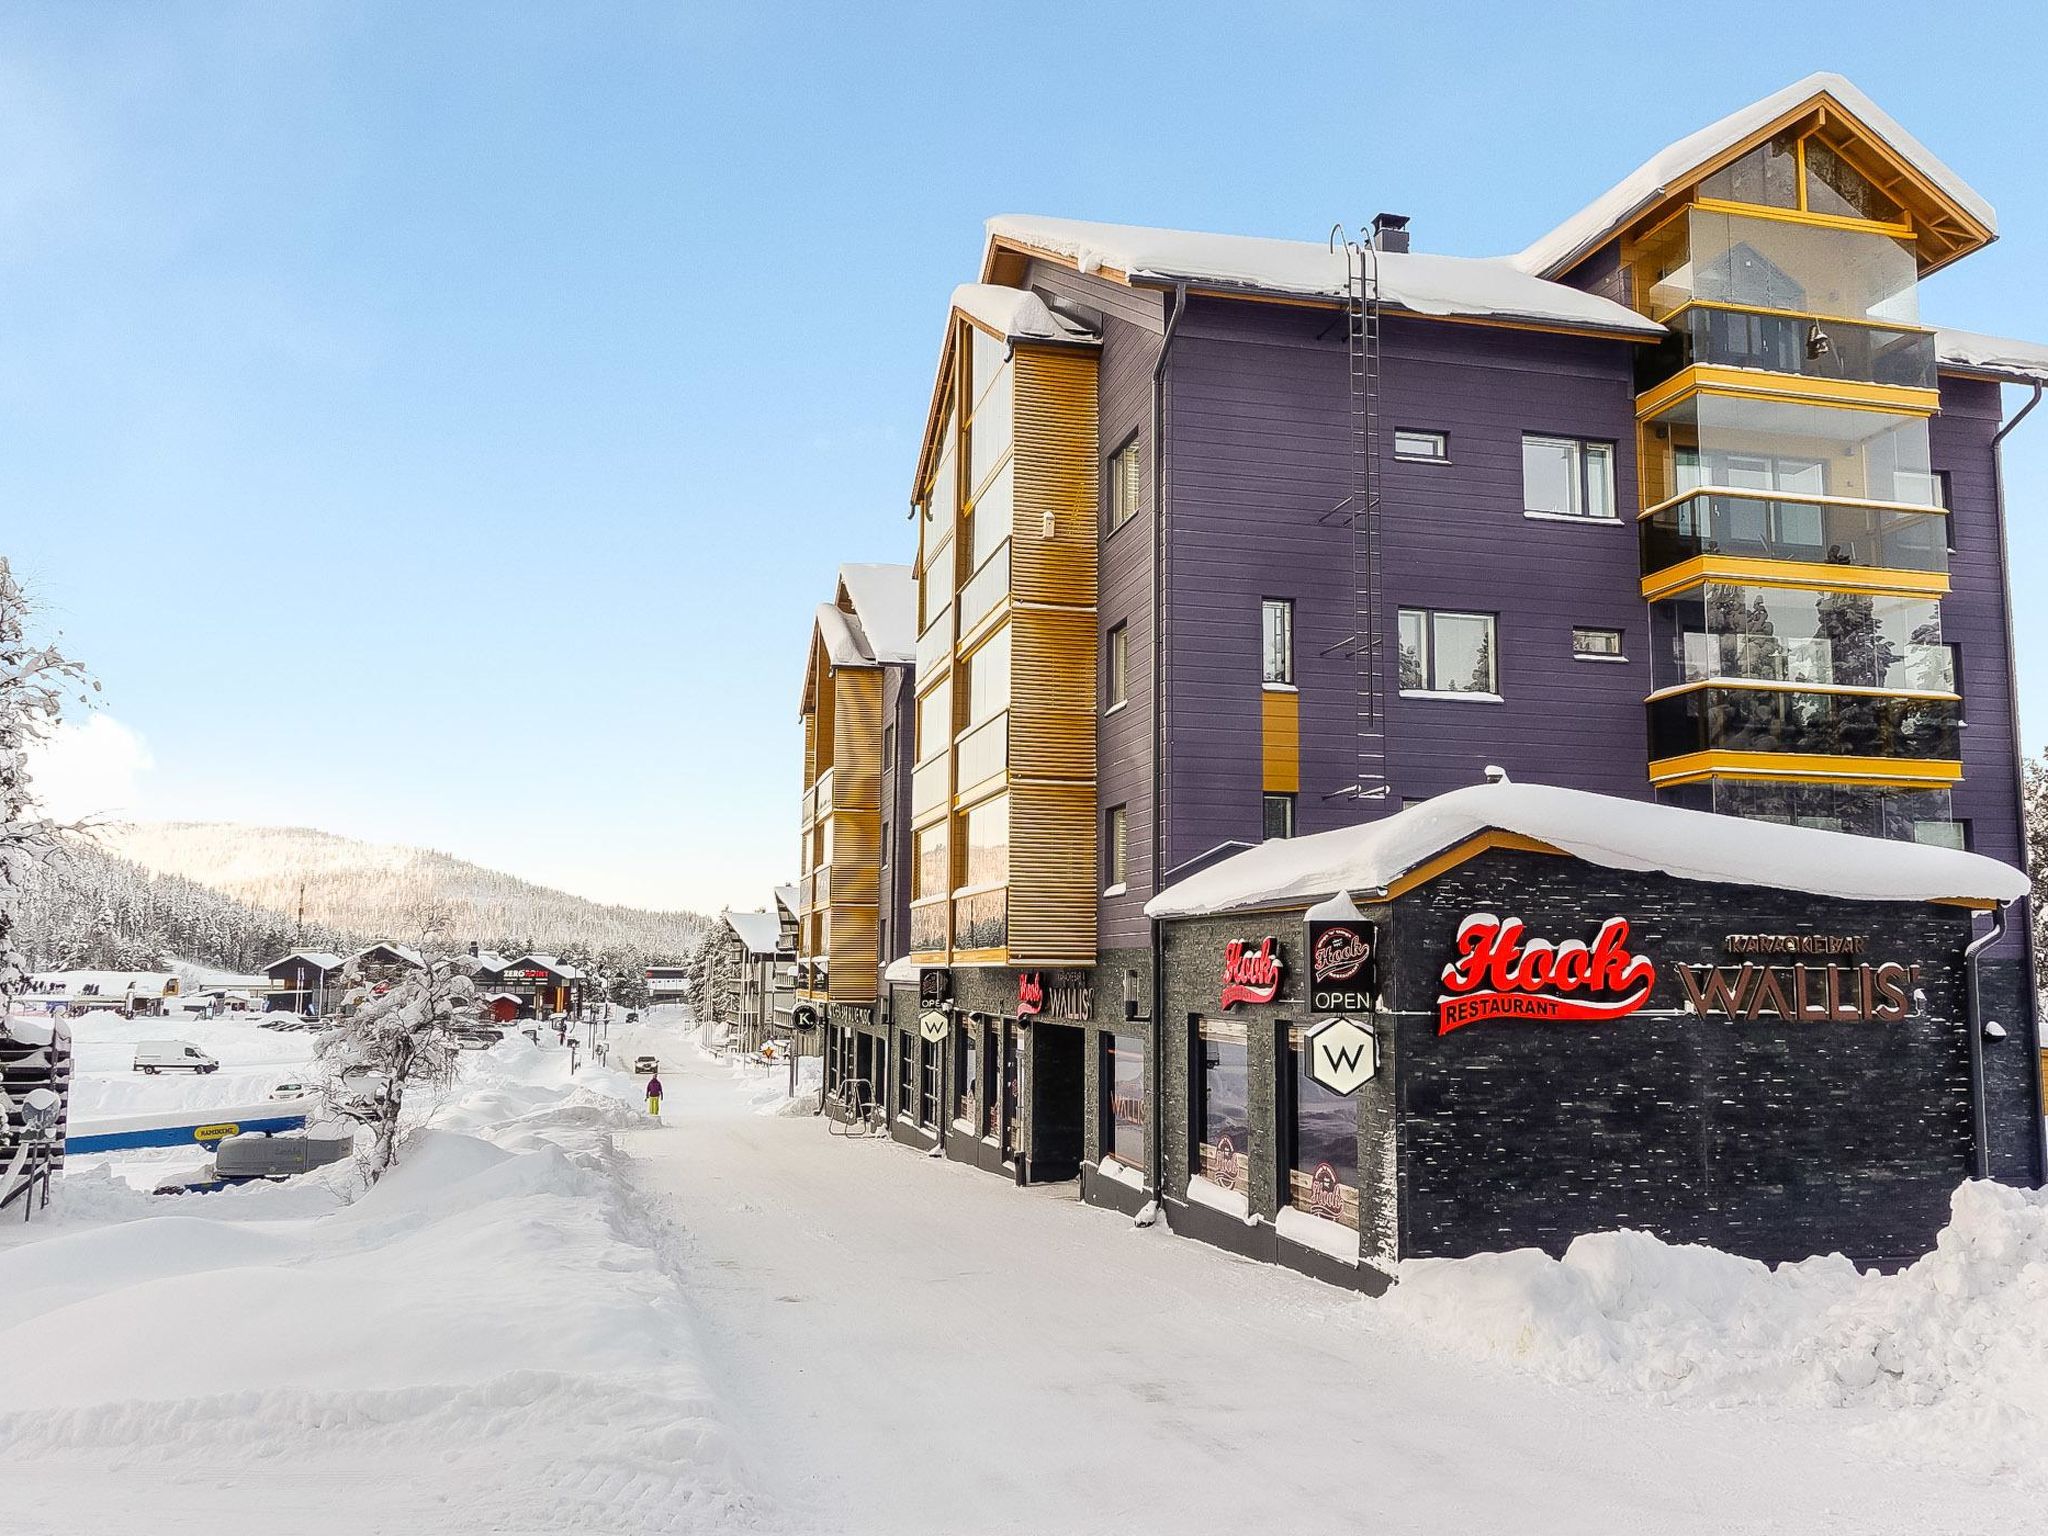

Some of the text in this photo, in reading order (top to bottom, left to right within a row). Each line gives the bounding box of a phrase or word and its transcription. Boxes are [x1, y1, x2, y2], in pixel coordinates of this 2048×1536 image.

[1222, 936, 1279, 984] Hook
[1314, 935, 1370, 970] Hook
[1442, 915, 1655, 991] Hook
[921, 1000, 942, 1008] OPE
[1315, 992, 1370, 1009] OPEN
[1446, 998, 1559, 1025] RESTAURANT
[924, 1021, 944, 1035] W
[1322, 1044, 1365, 1075] W
